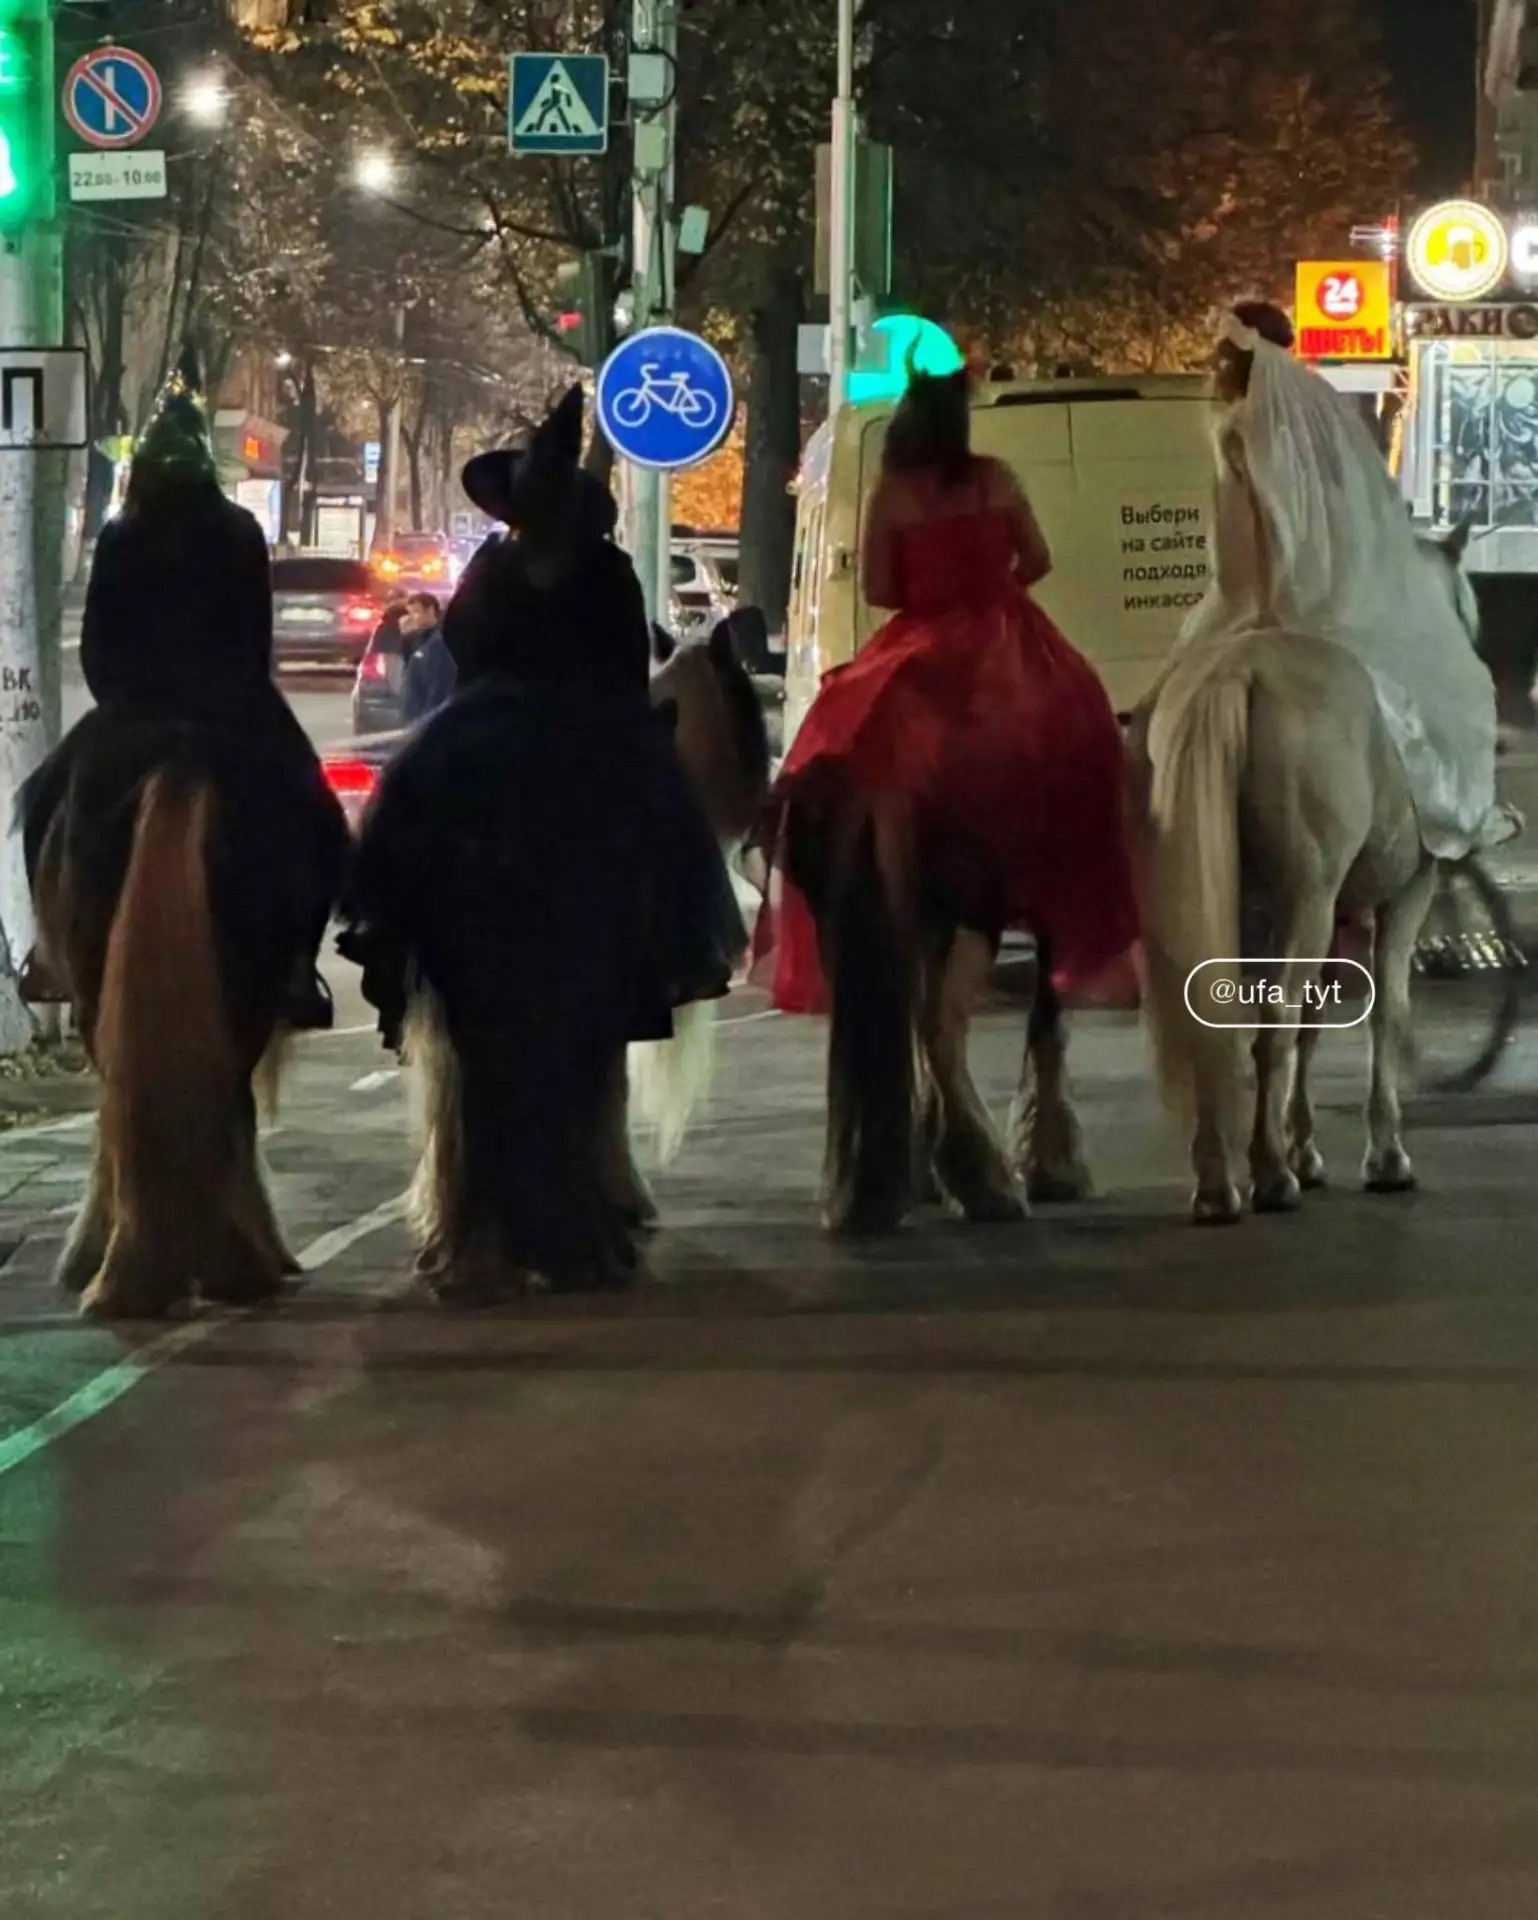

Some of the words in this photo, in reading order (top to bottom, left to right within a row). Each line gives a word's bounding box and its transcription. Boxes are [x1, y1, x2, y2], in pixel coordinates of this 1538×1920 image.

[1324, 276, 1358, 302] 24
[1301, 328, 1384, 354] ЦВЕТЫ
[1121, 503, 1200, 525] Выбери
[1122, 538, 1145, 553] на
[1150, 530, 1207, 552] сайте
[1122, 564, 1207, 582] подходя
